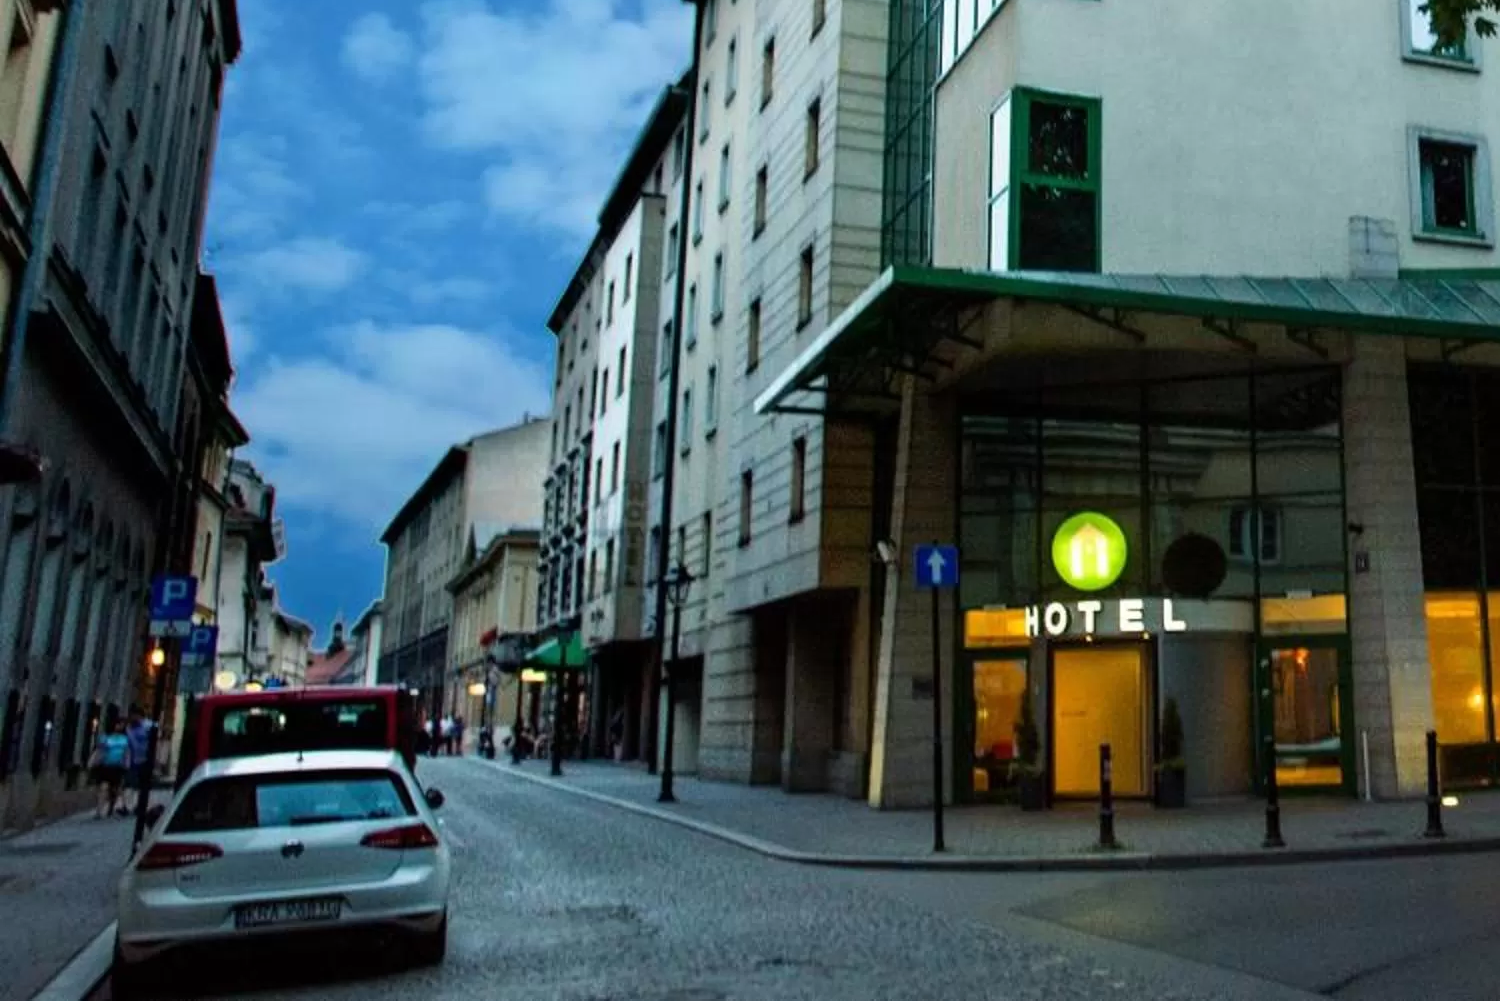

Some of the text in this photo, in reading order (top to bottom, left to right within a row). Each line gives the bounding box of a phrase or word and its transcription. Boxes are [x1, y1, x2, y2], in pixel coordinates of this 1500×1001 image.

[163, 579, 187, 606] P
[1024, 598, 1187, 637] HOTEL
[191, 629, 211, 648] P
